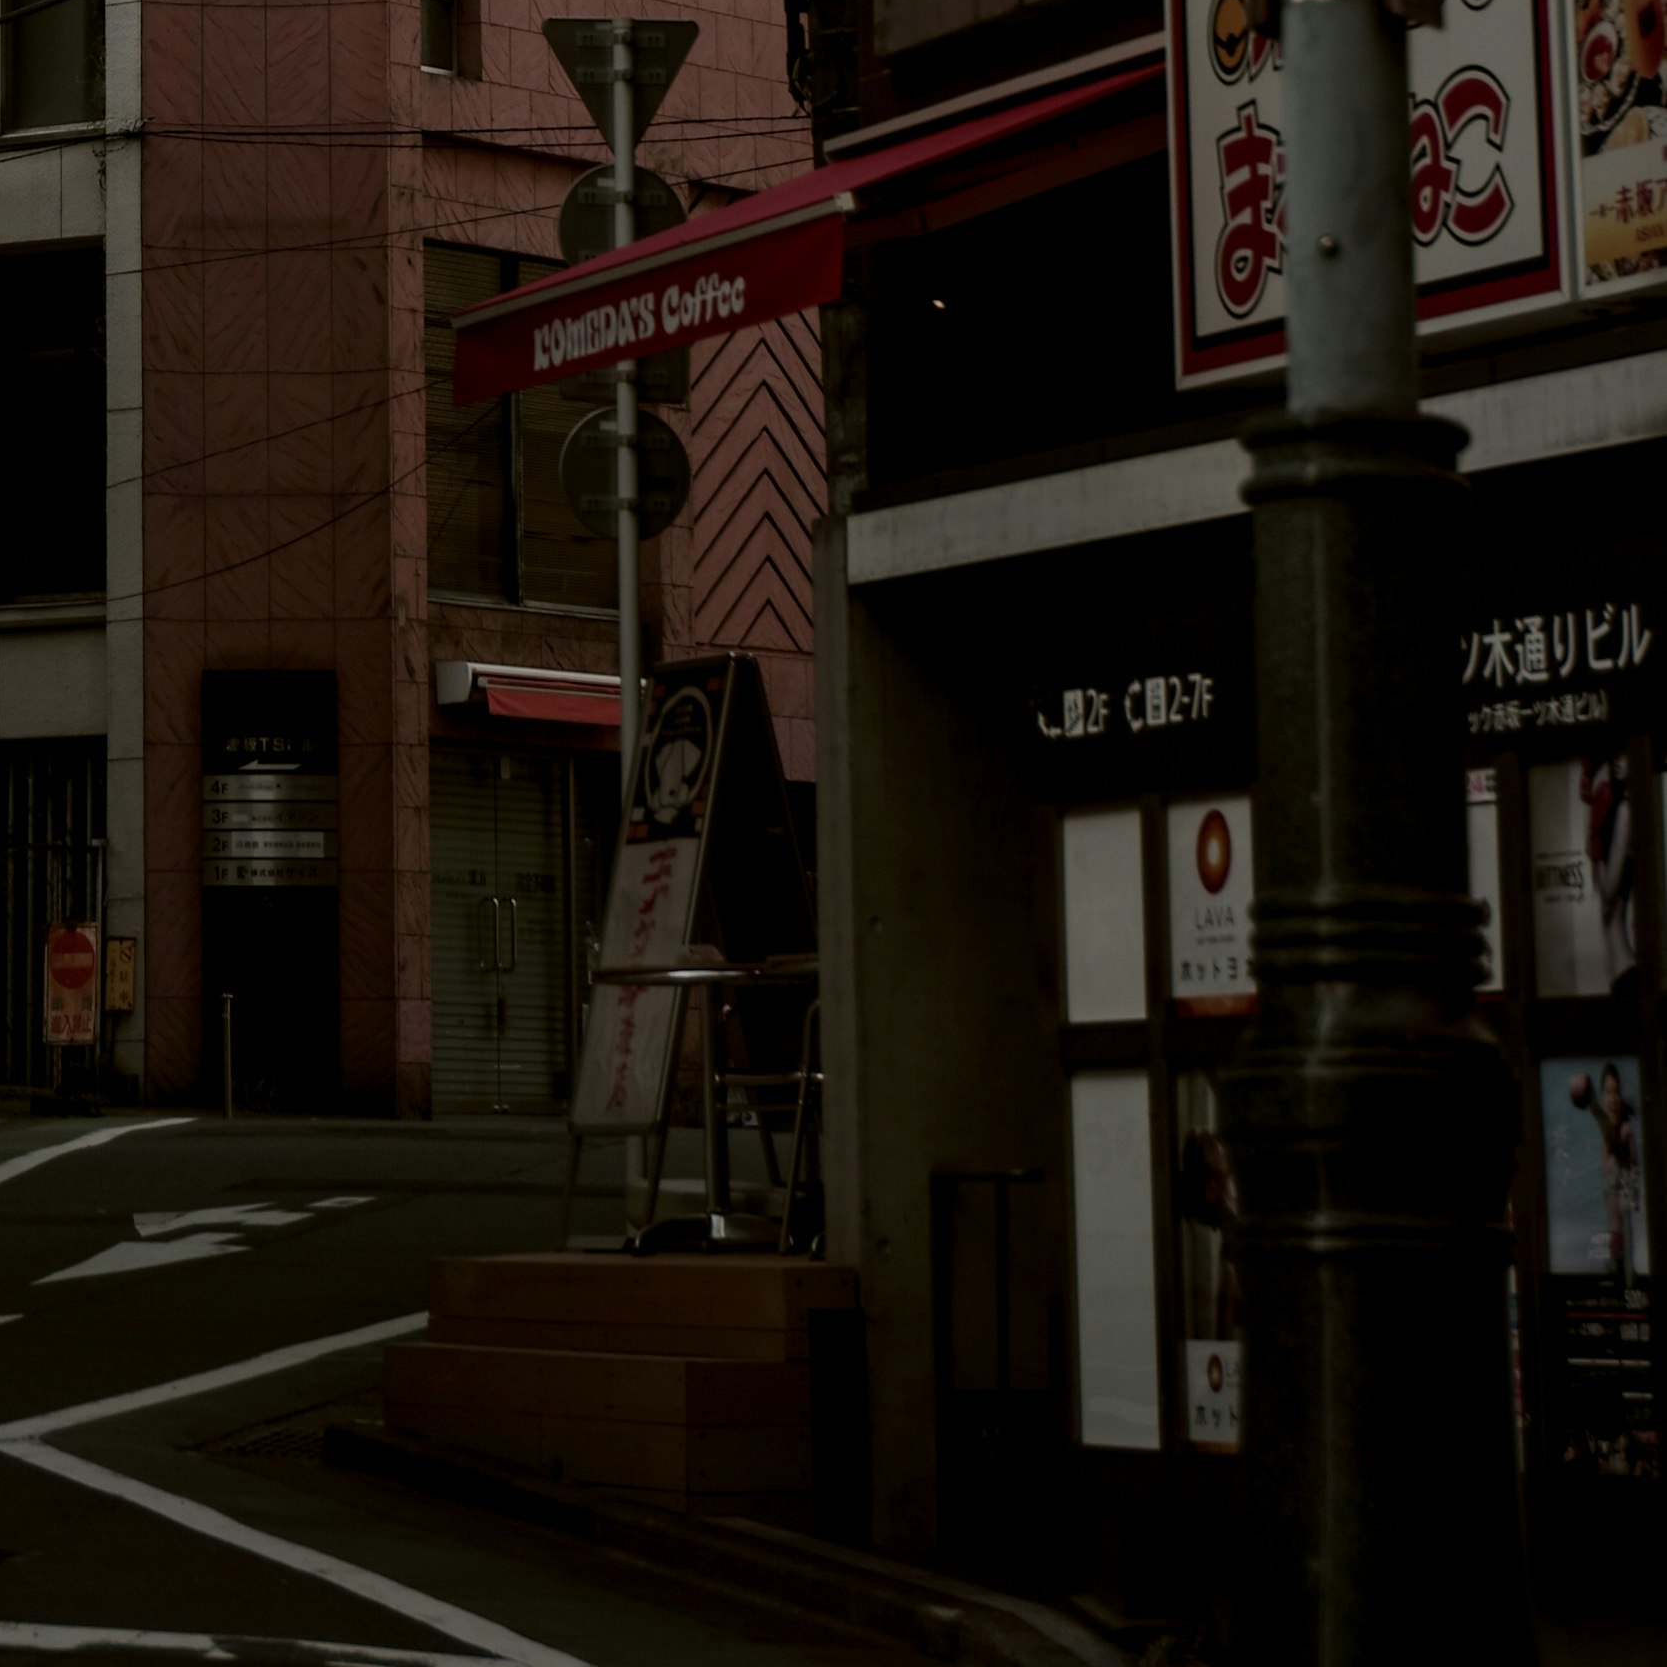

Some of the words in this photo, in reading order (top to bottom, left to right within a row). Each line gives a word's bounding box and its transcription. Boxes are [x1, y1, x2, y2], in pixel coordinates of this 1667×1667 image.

[533, 291, 656, 373] KOMEDA'S
[661, 271, 747, 336] Coffee
[211, 780, 228, 794] 4F
[212, 808, 228, 824] 3F
[212, 837, 228, 852] 2F
[214, 866, 228, 880] 1F
[1181, 955, 1237, 981] ホットヨ
